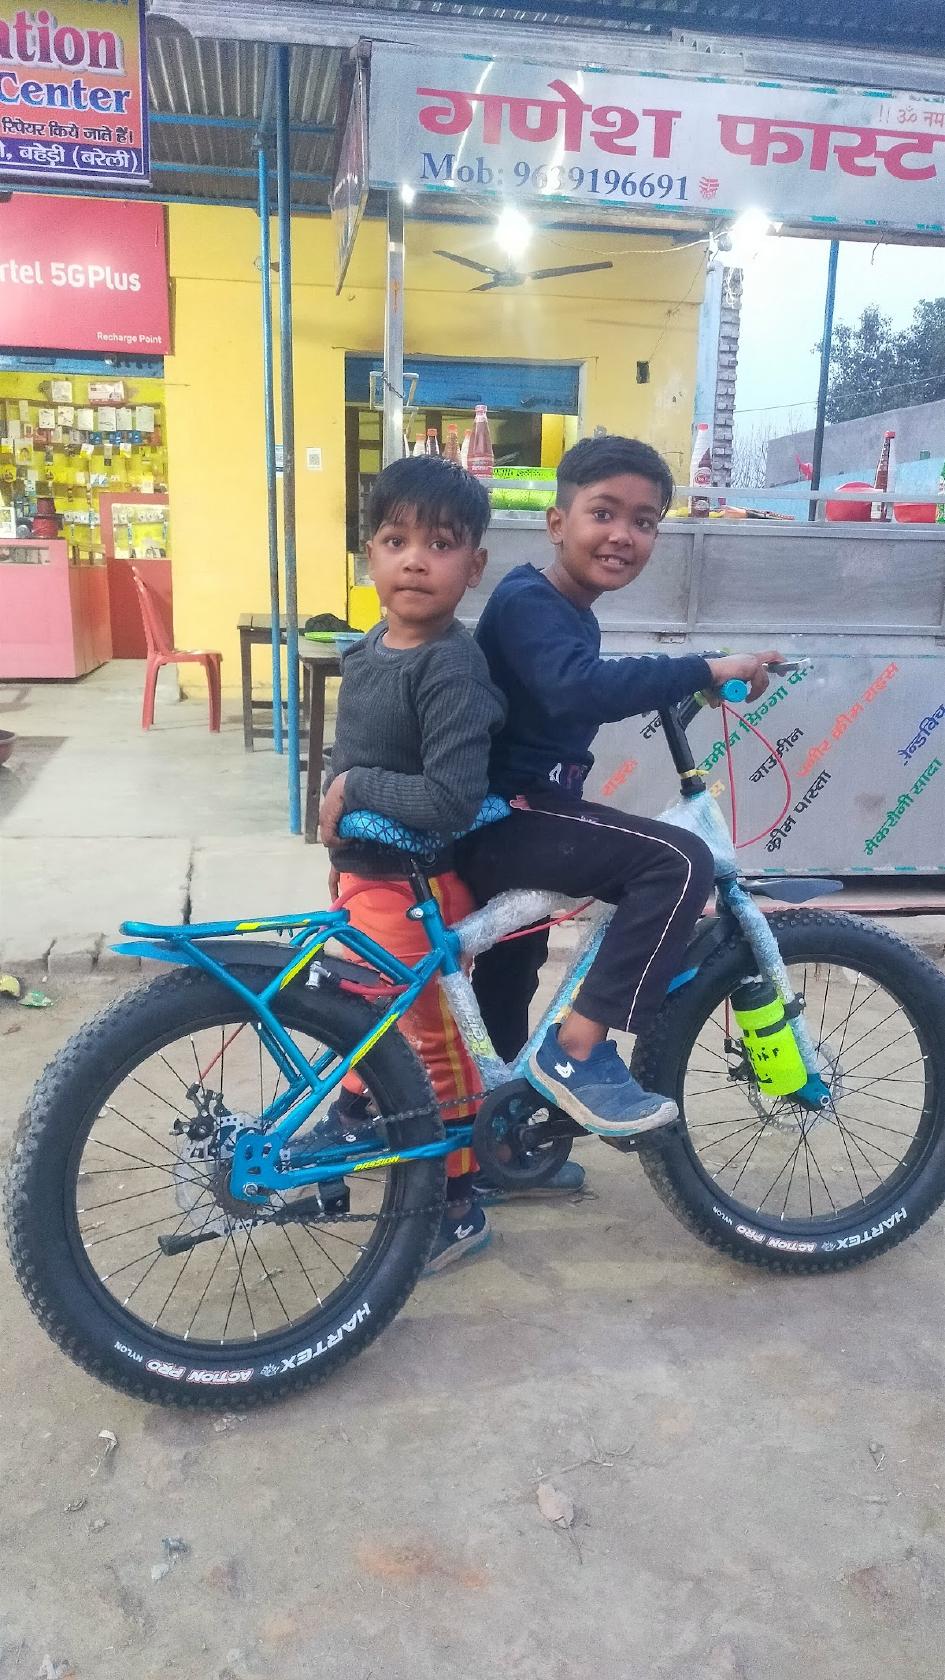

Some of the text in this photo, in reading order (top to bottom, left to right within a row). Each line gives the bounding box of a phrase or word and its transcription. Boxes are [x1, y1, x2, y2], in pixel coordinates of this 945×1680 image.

[0, 72, 130, 113] Center
[83, 126, 112, 141] जाते
[416, 79, 945, 181] गणेश फास्ट
[97, 332, 162, 344] Recharge Point
[735, 1224, 766, 1244] PRO
[835, 1206, 909, 1250] HARTEX
[767, 1237, 817, 1254] ACTION
[113, 1302, 371, 1384] HARTEX ACTION PRO NYLON
